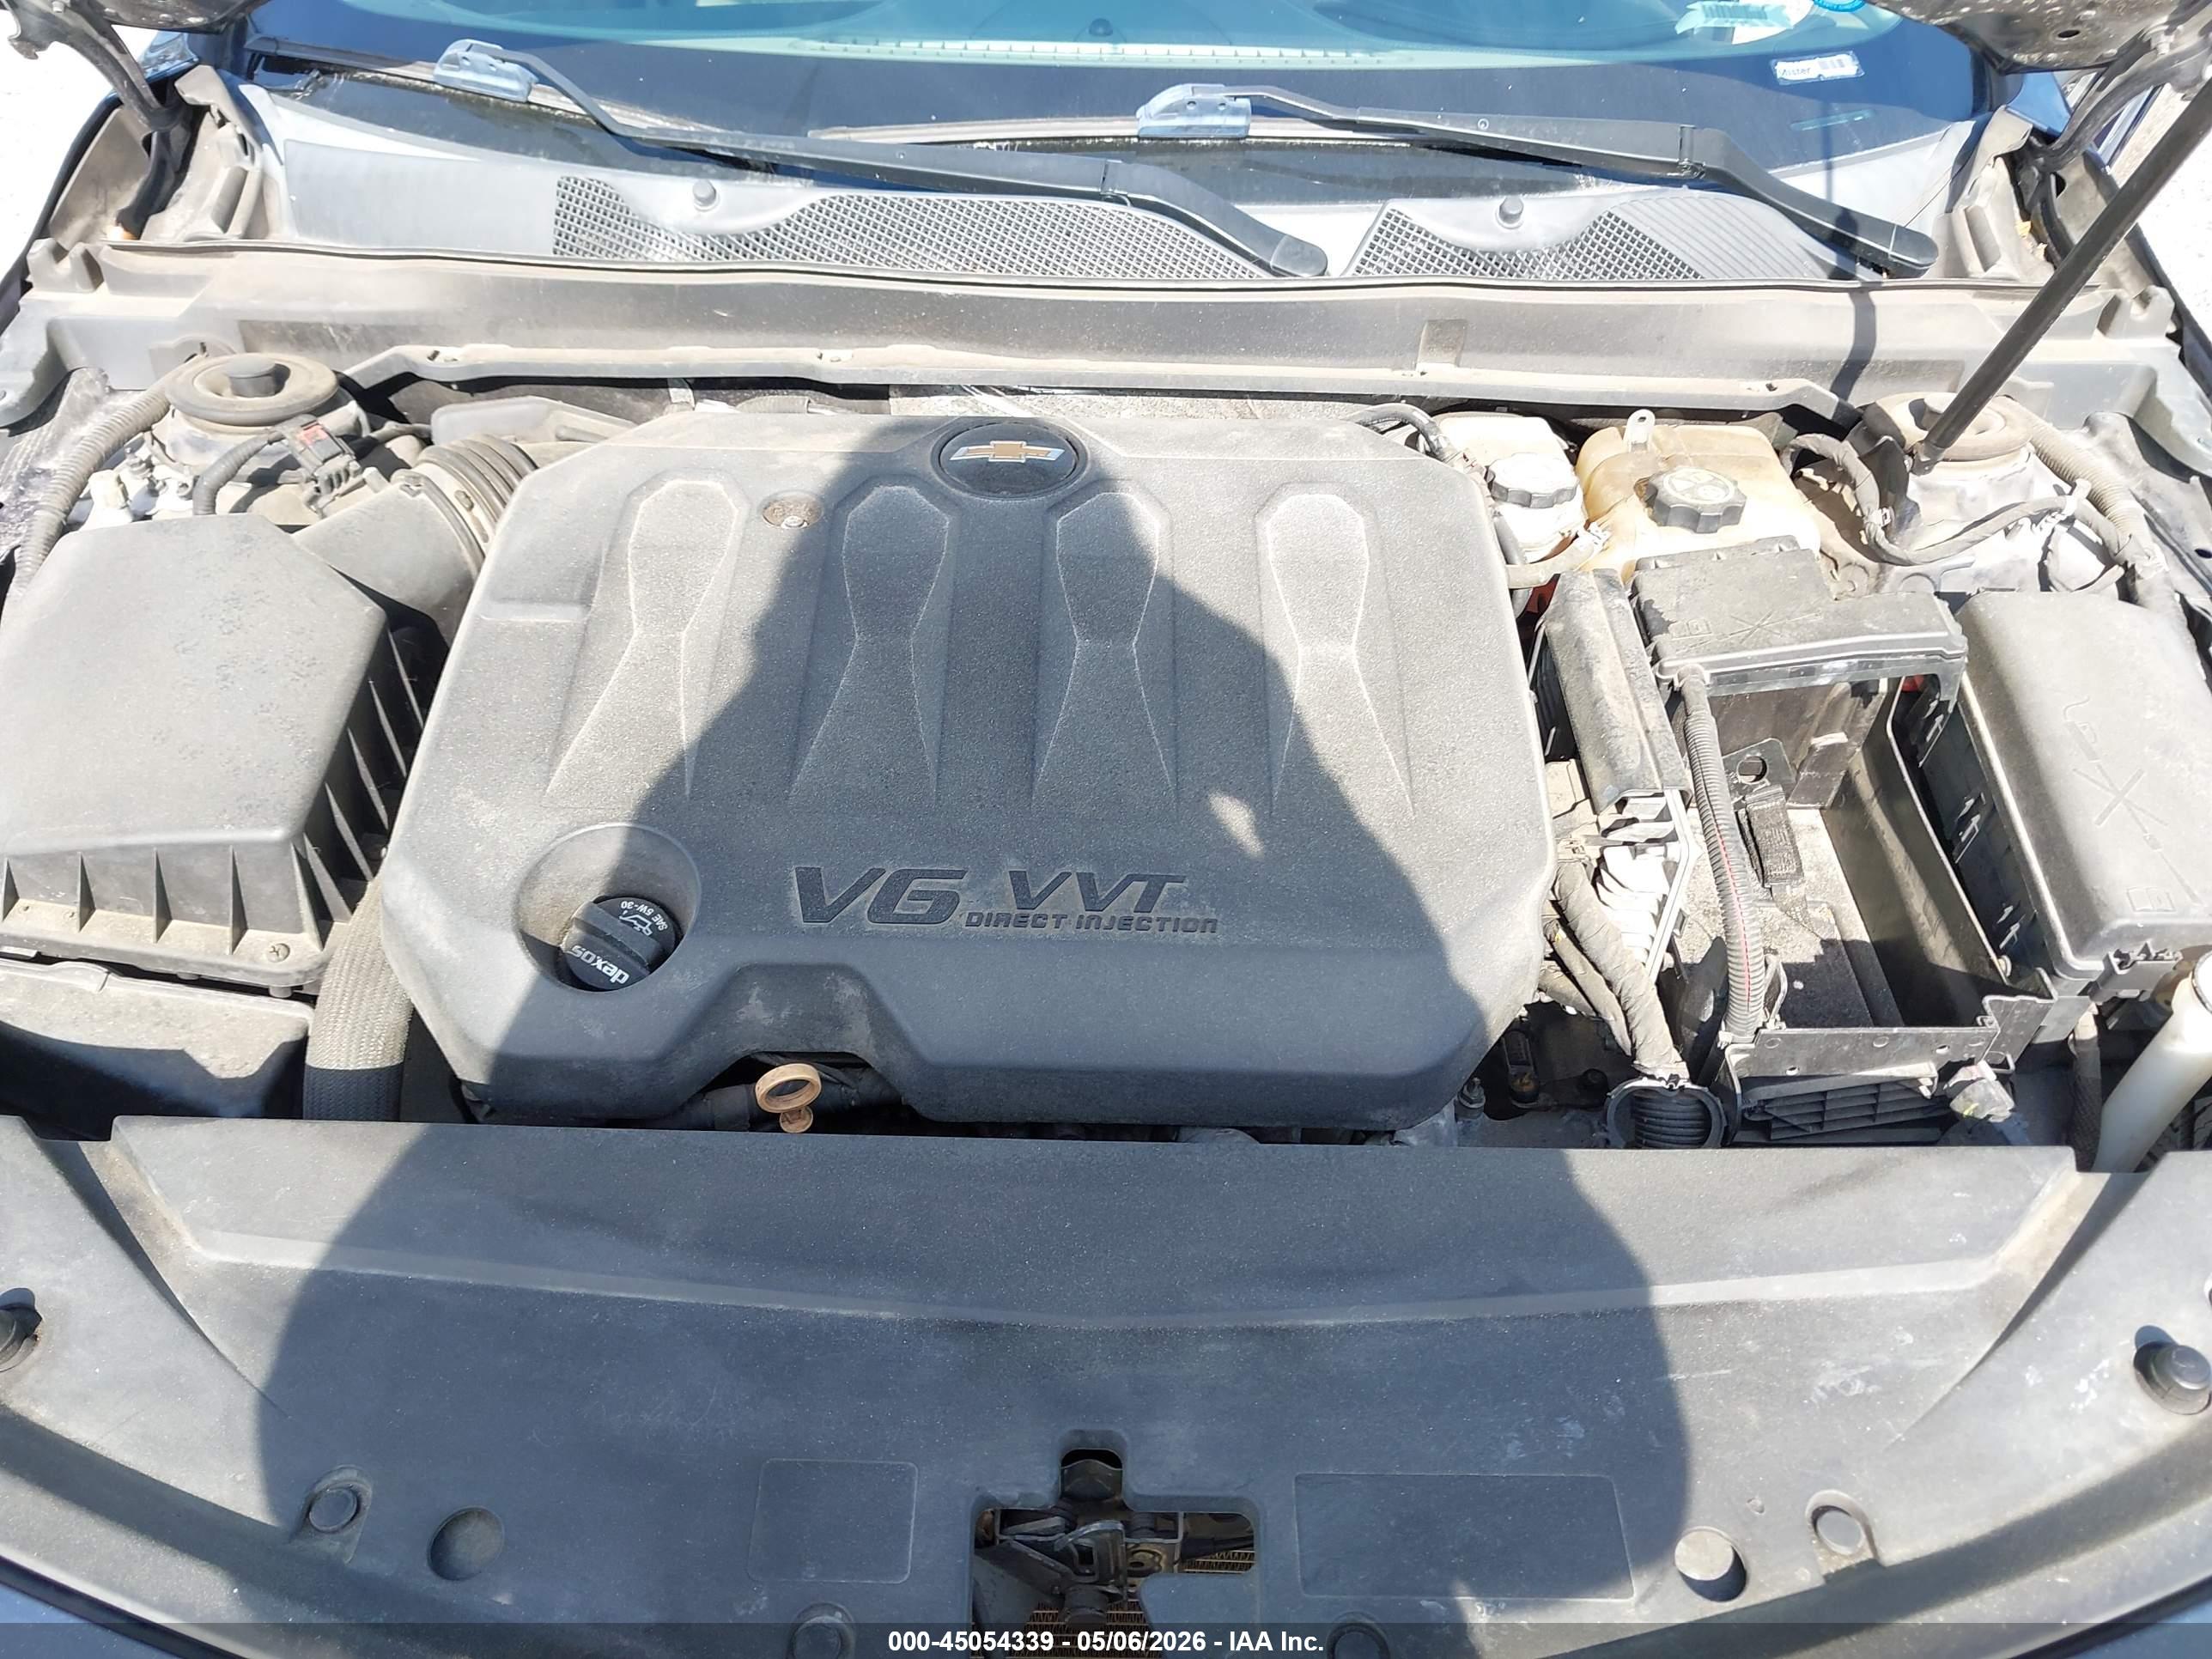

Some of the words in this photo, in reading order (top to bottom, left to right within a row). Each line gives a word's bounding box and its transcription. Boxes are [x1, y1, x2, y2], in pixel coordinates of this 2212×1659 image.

[793, 866, 969, 925] V6
[1007, 870, 1188, 914] VVT
[620, 900, 655, 917] 5W-30
[651, 914, 669, 932] SAE
[963, 912, 1068, 930] DIRECT
[1075, 915, 1218, 933] INJECTION
[570, 945, 629, 984] dexos
